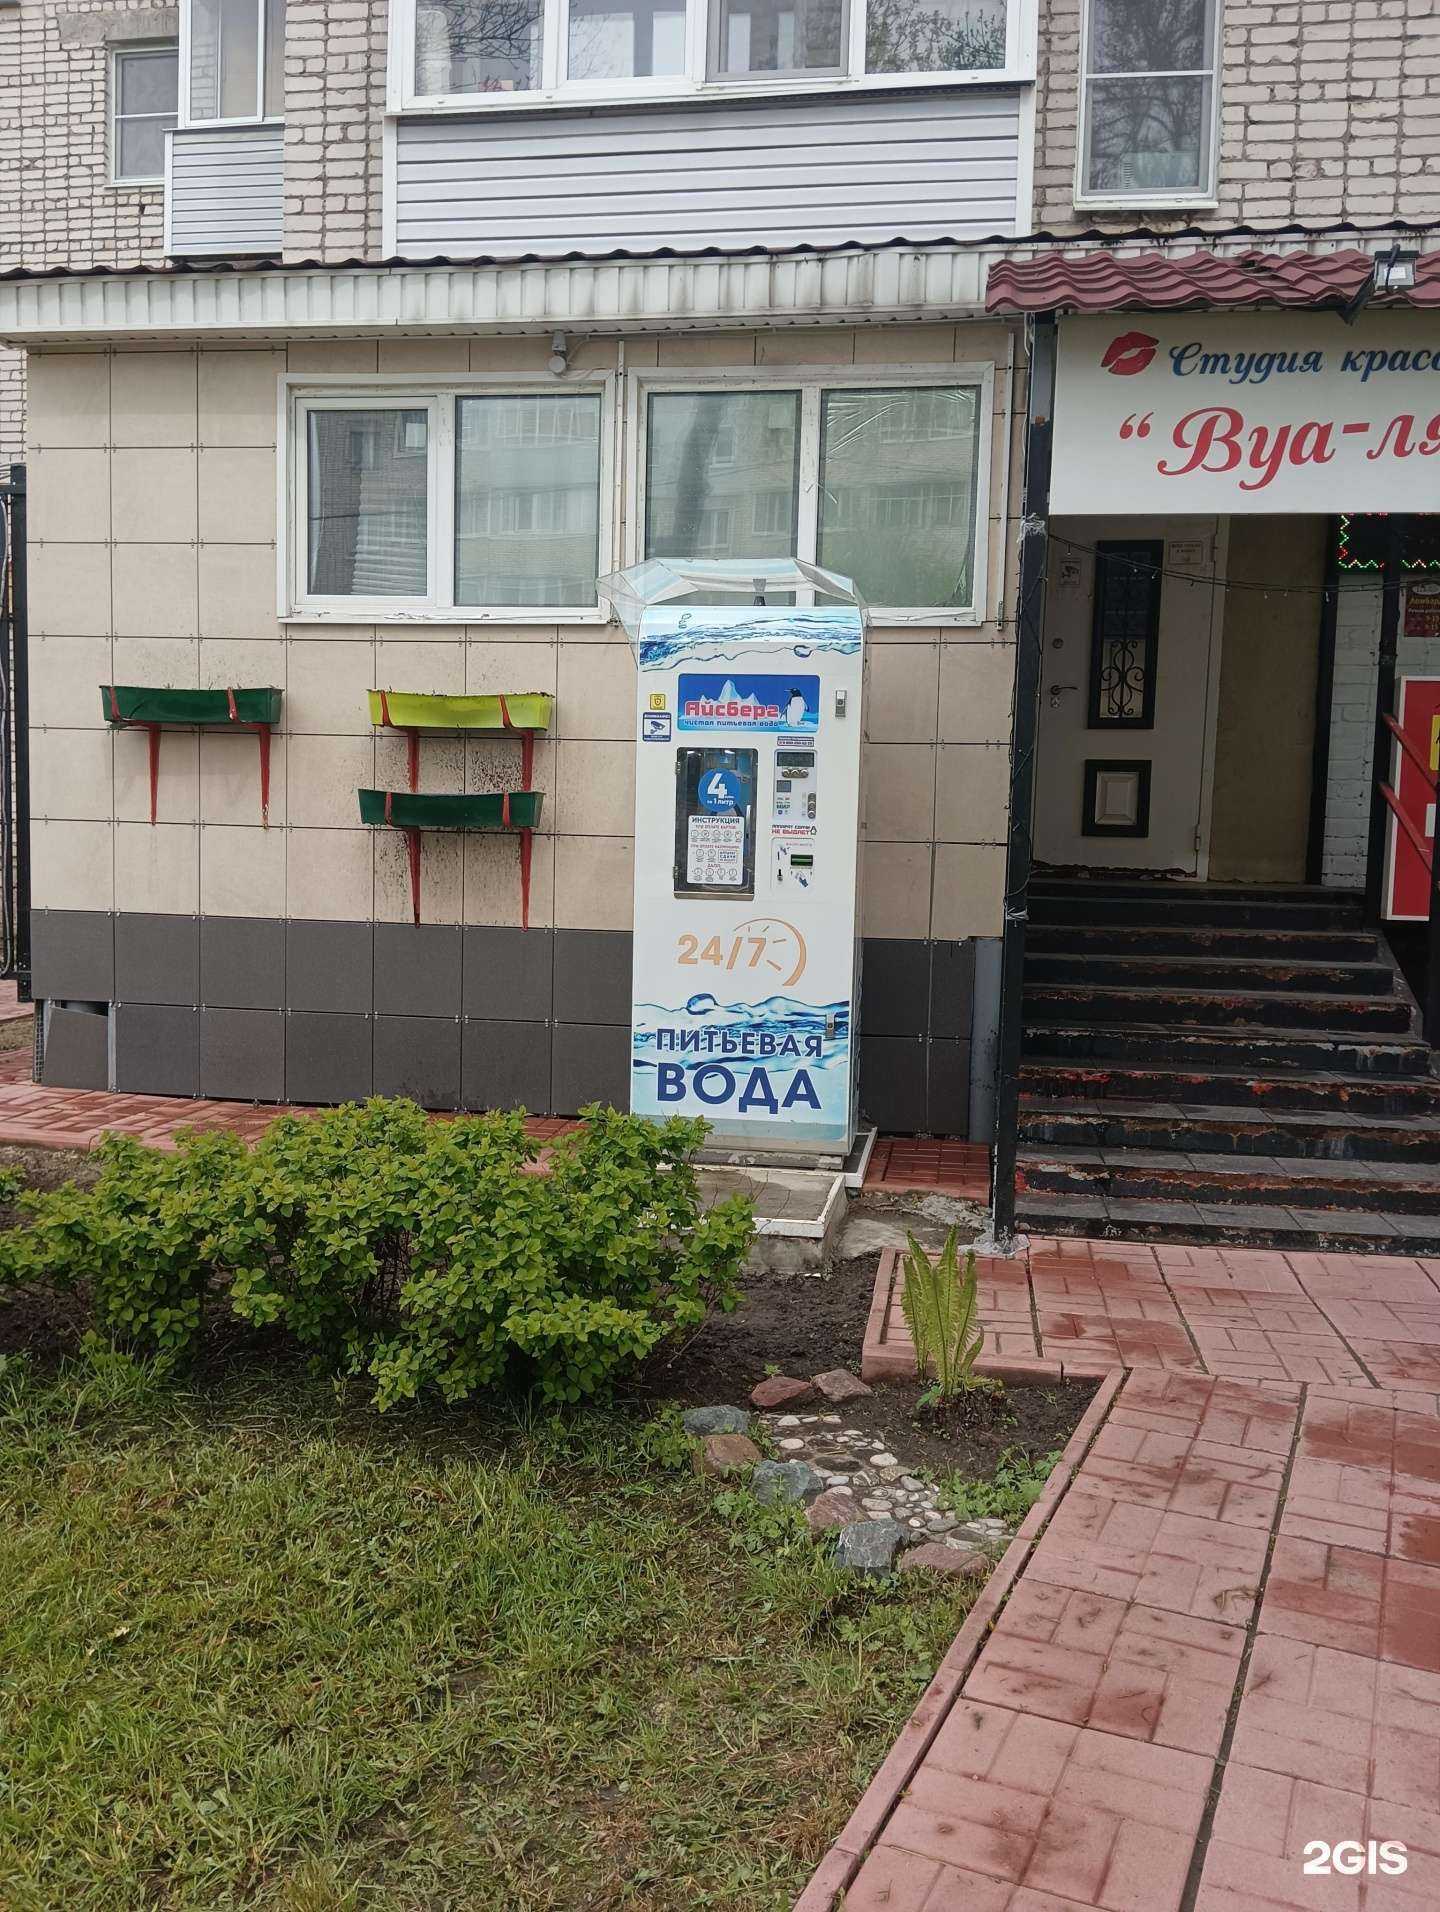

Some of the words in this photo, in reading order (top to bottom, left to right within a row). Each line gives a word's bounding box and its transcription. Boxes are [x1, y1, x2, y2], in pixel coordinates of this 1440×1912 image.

[1169, 341, 1323, 385] Студия
[685, 701, 779, 720] Айсберг
[706, 772, 728, 800] 4
[691, 816, 740, 825] ИНСТРУКЦИЯ
[677, 934, 767, 970] 24/7
[656, 1028, 823, 1058] ПИТЬЕВАЯ
[656, 1062, 822, 1115] ВОДА
